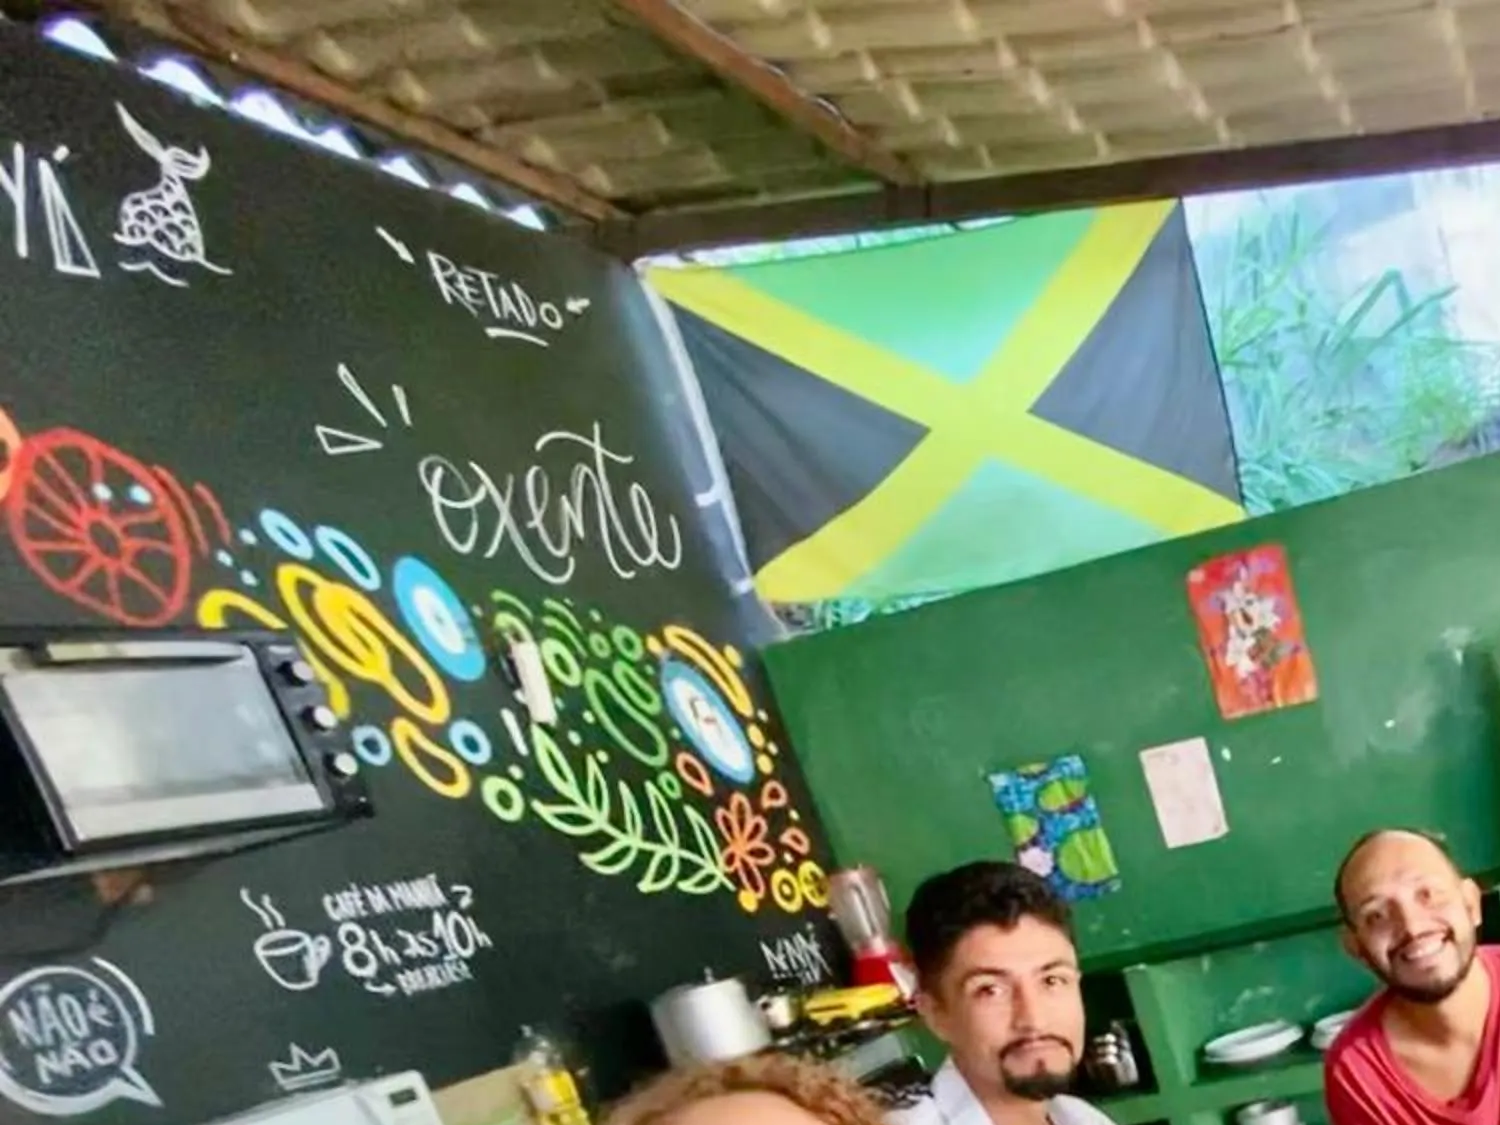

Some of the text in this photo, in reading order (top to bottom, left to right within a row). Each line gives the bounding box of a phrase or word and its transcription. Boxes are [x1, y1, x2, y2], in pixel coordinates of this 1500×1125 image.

[426, 250, 564, 330] RETADO
[337, 921, 402, 978] 8h
[433, 910, 493, 961] 10h
[7, 983, 91, 1047] NÃO
